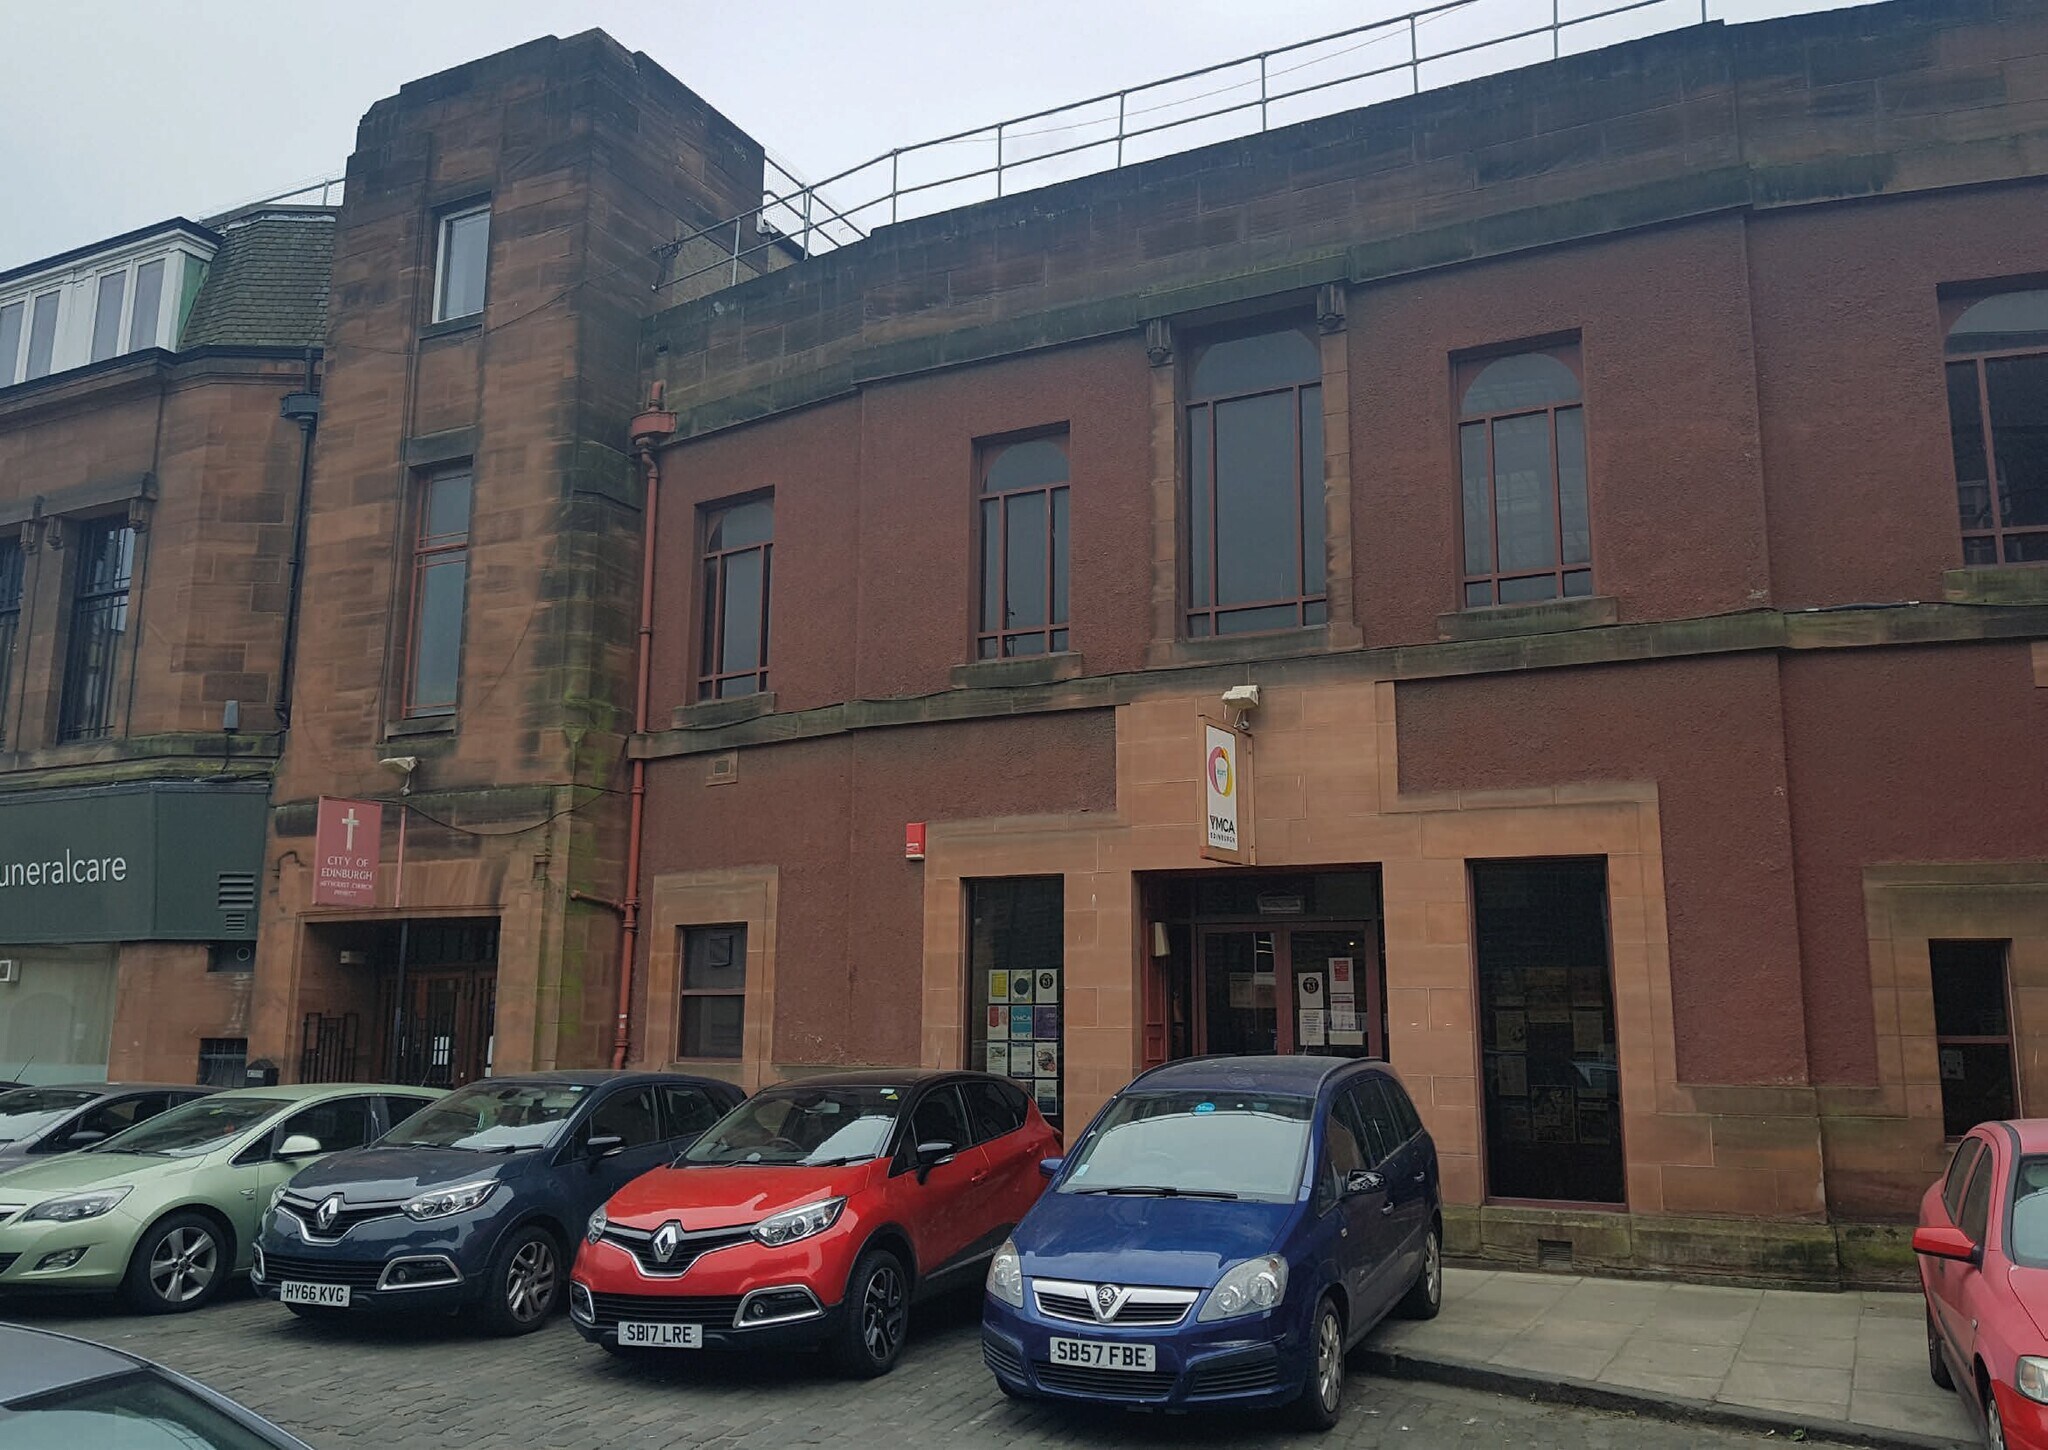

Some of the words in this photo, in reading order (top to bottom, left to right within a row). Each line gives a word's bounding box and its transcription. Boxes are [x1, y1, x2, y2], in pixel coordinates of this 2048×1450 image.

[1210, 815, 1235, 834] YMCA
[0, 848, 127, 887] uneralcare
[327, 856, 351, 866] CITY
[356, 857, 369, 868] OF
[321, 867, 373, 881] EDINBURGH
[286, 1283, 317, 1300] HY66
[319, 1286, 345, 1302] KVG
[627, 1324, 659, 1342] SB17
[662, 1325, 693, 1343] LRE
[1057, 1341, 1104, 1364] SB57
[1109, 1346, 1147, 1367] FBE
